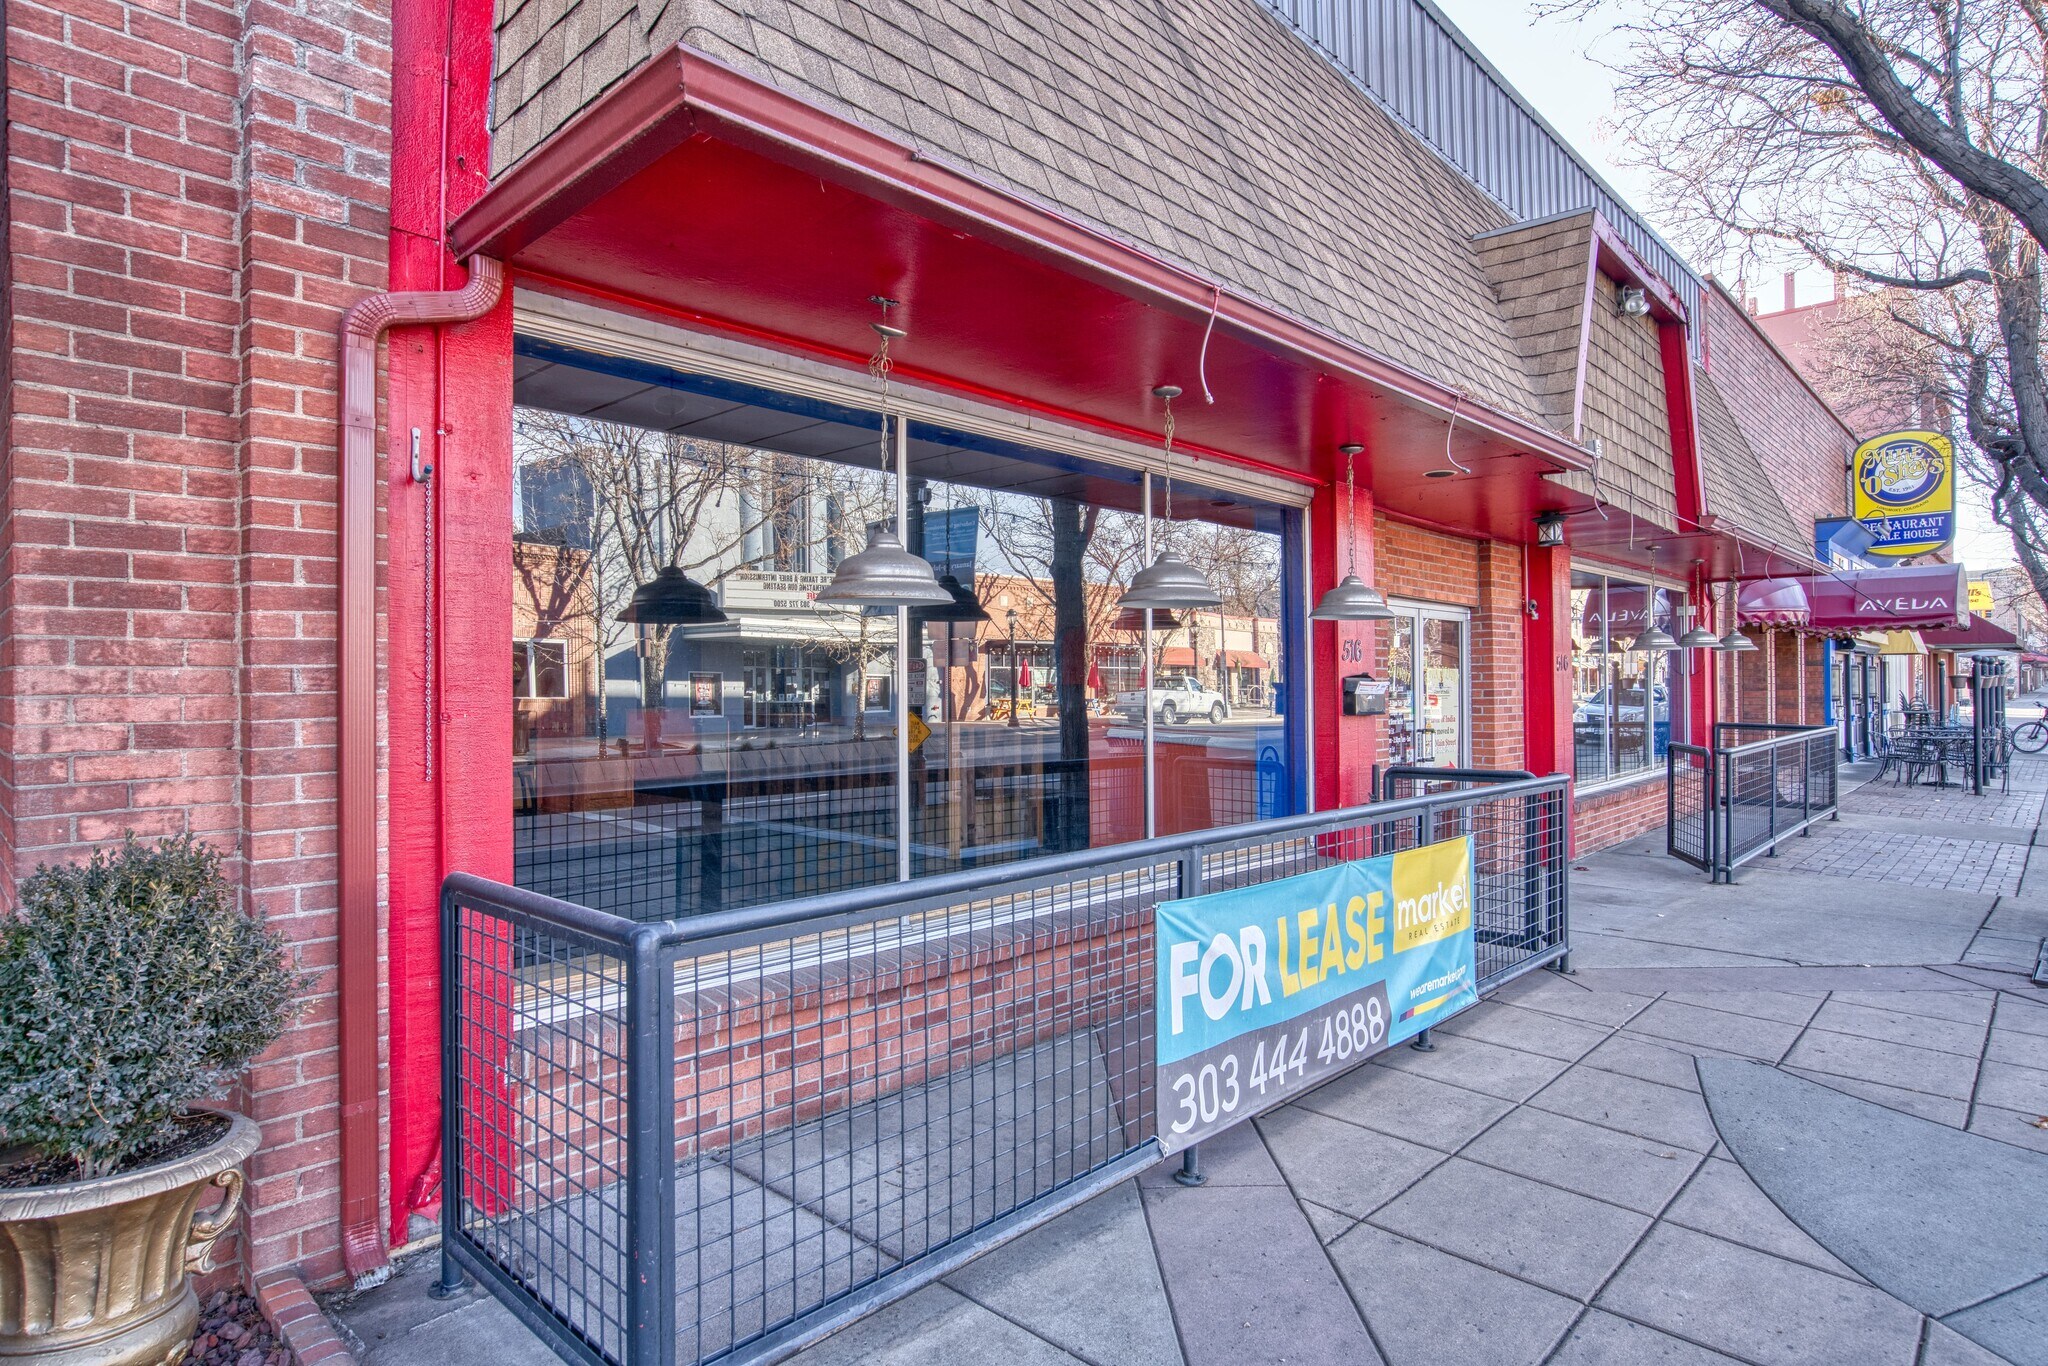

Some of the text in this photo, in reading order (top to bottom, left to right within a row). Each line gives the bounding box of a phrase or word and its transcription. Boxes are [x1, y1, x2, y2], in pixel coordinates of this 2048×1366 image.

[1903, 500, 1930, 512] COLORADO
[1903, 529, 1940, 539] HOUSE
[1341, 639, 1363, 663] 516
[1556, 654, 1569, 671] 516
[1446, 714, 1456, 723] India
[1437, 727, 1449, 735] moved
[1397, 874, 1469, 931] market
[1408, 916, 1461, 940] REAL ESTATE
[1170, 890, 1385, 1036] FOR LEASE
[1171, 996, 1386, 1134] 303 444 4888
